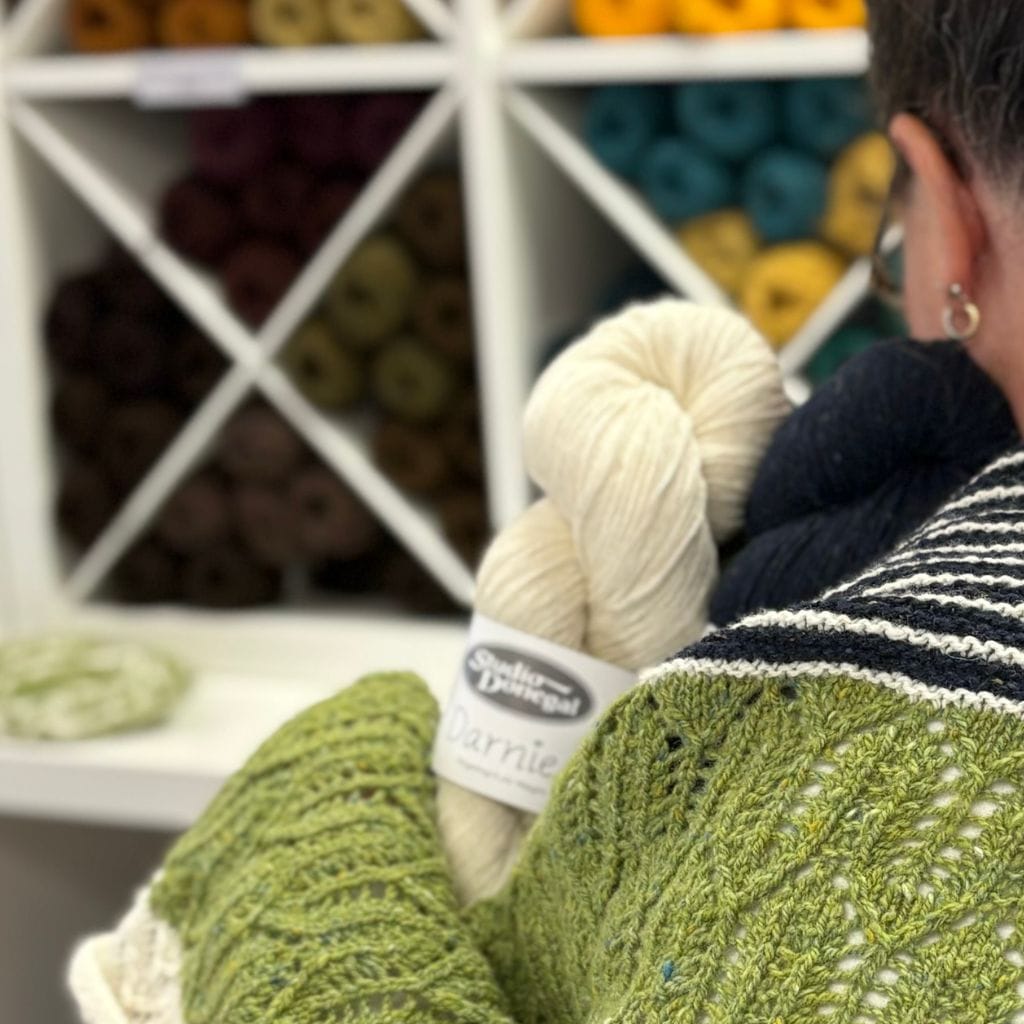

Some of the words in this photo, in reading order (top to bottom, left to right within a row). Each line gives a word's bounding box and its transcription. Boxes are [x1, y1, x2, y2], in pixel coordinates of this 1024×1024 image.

[469, 648, 570, 693] Studio
[478, 669, 581, 716] Donegal
[447, 706, 557, 776] Darnie
